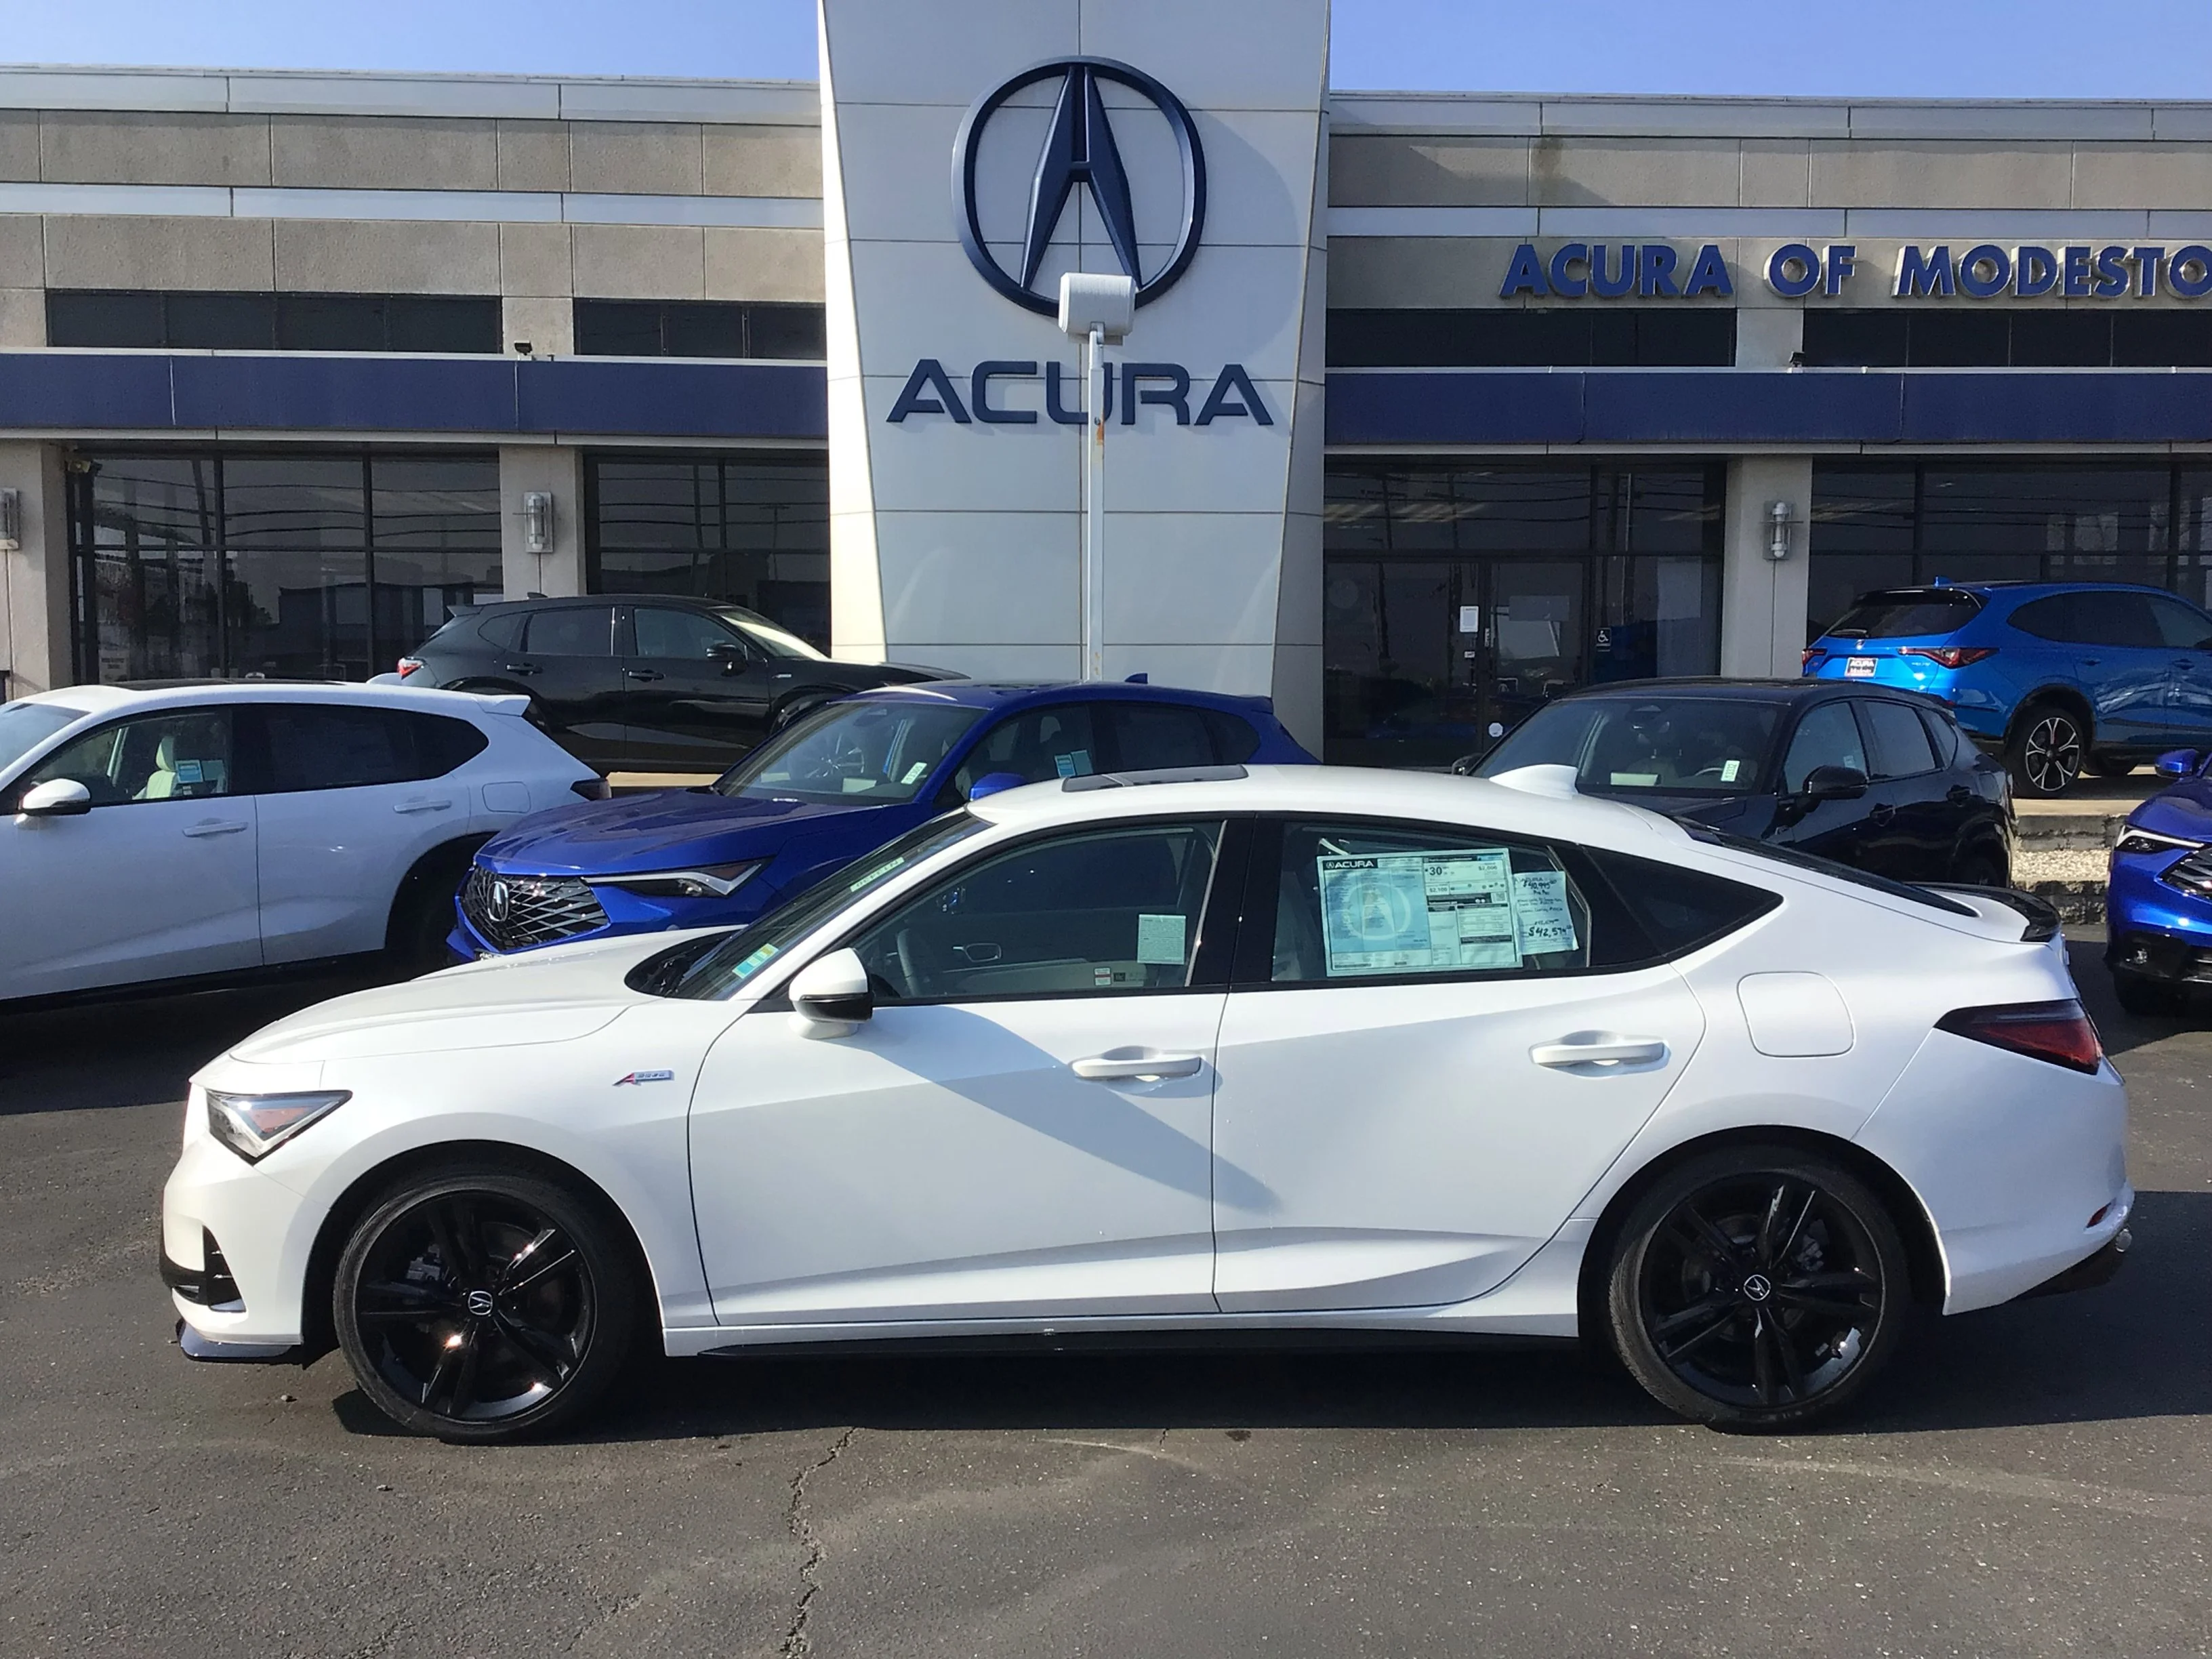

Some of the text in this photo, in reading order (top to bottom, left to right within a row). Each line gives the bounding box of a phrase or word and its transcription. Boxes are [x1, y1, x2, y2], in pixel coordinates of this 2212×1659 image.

[1498, 243, 2212, 297] ACURA OF MODESTO
[886, 359, 1274, 426] ACURA
[1334, 860, 1374, 868] ACURA
[1429, 866, 1442, 876] 30
